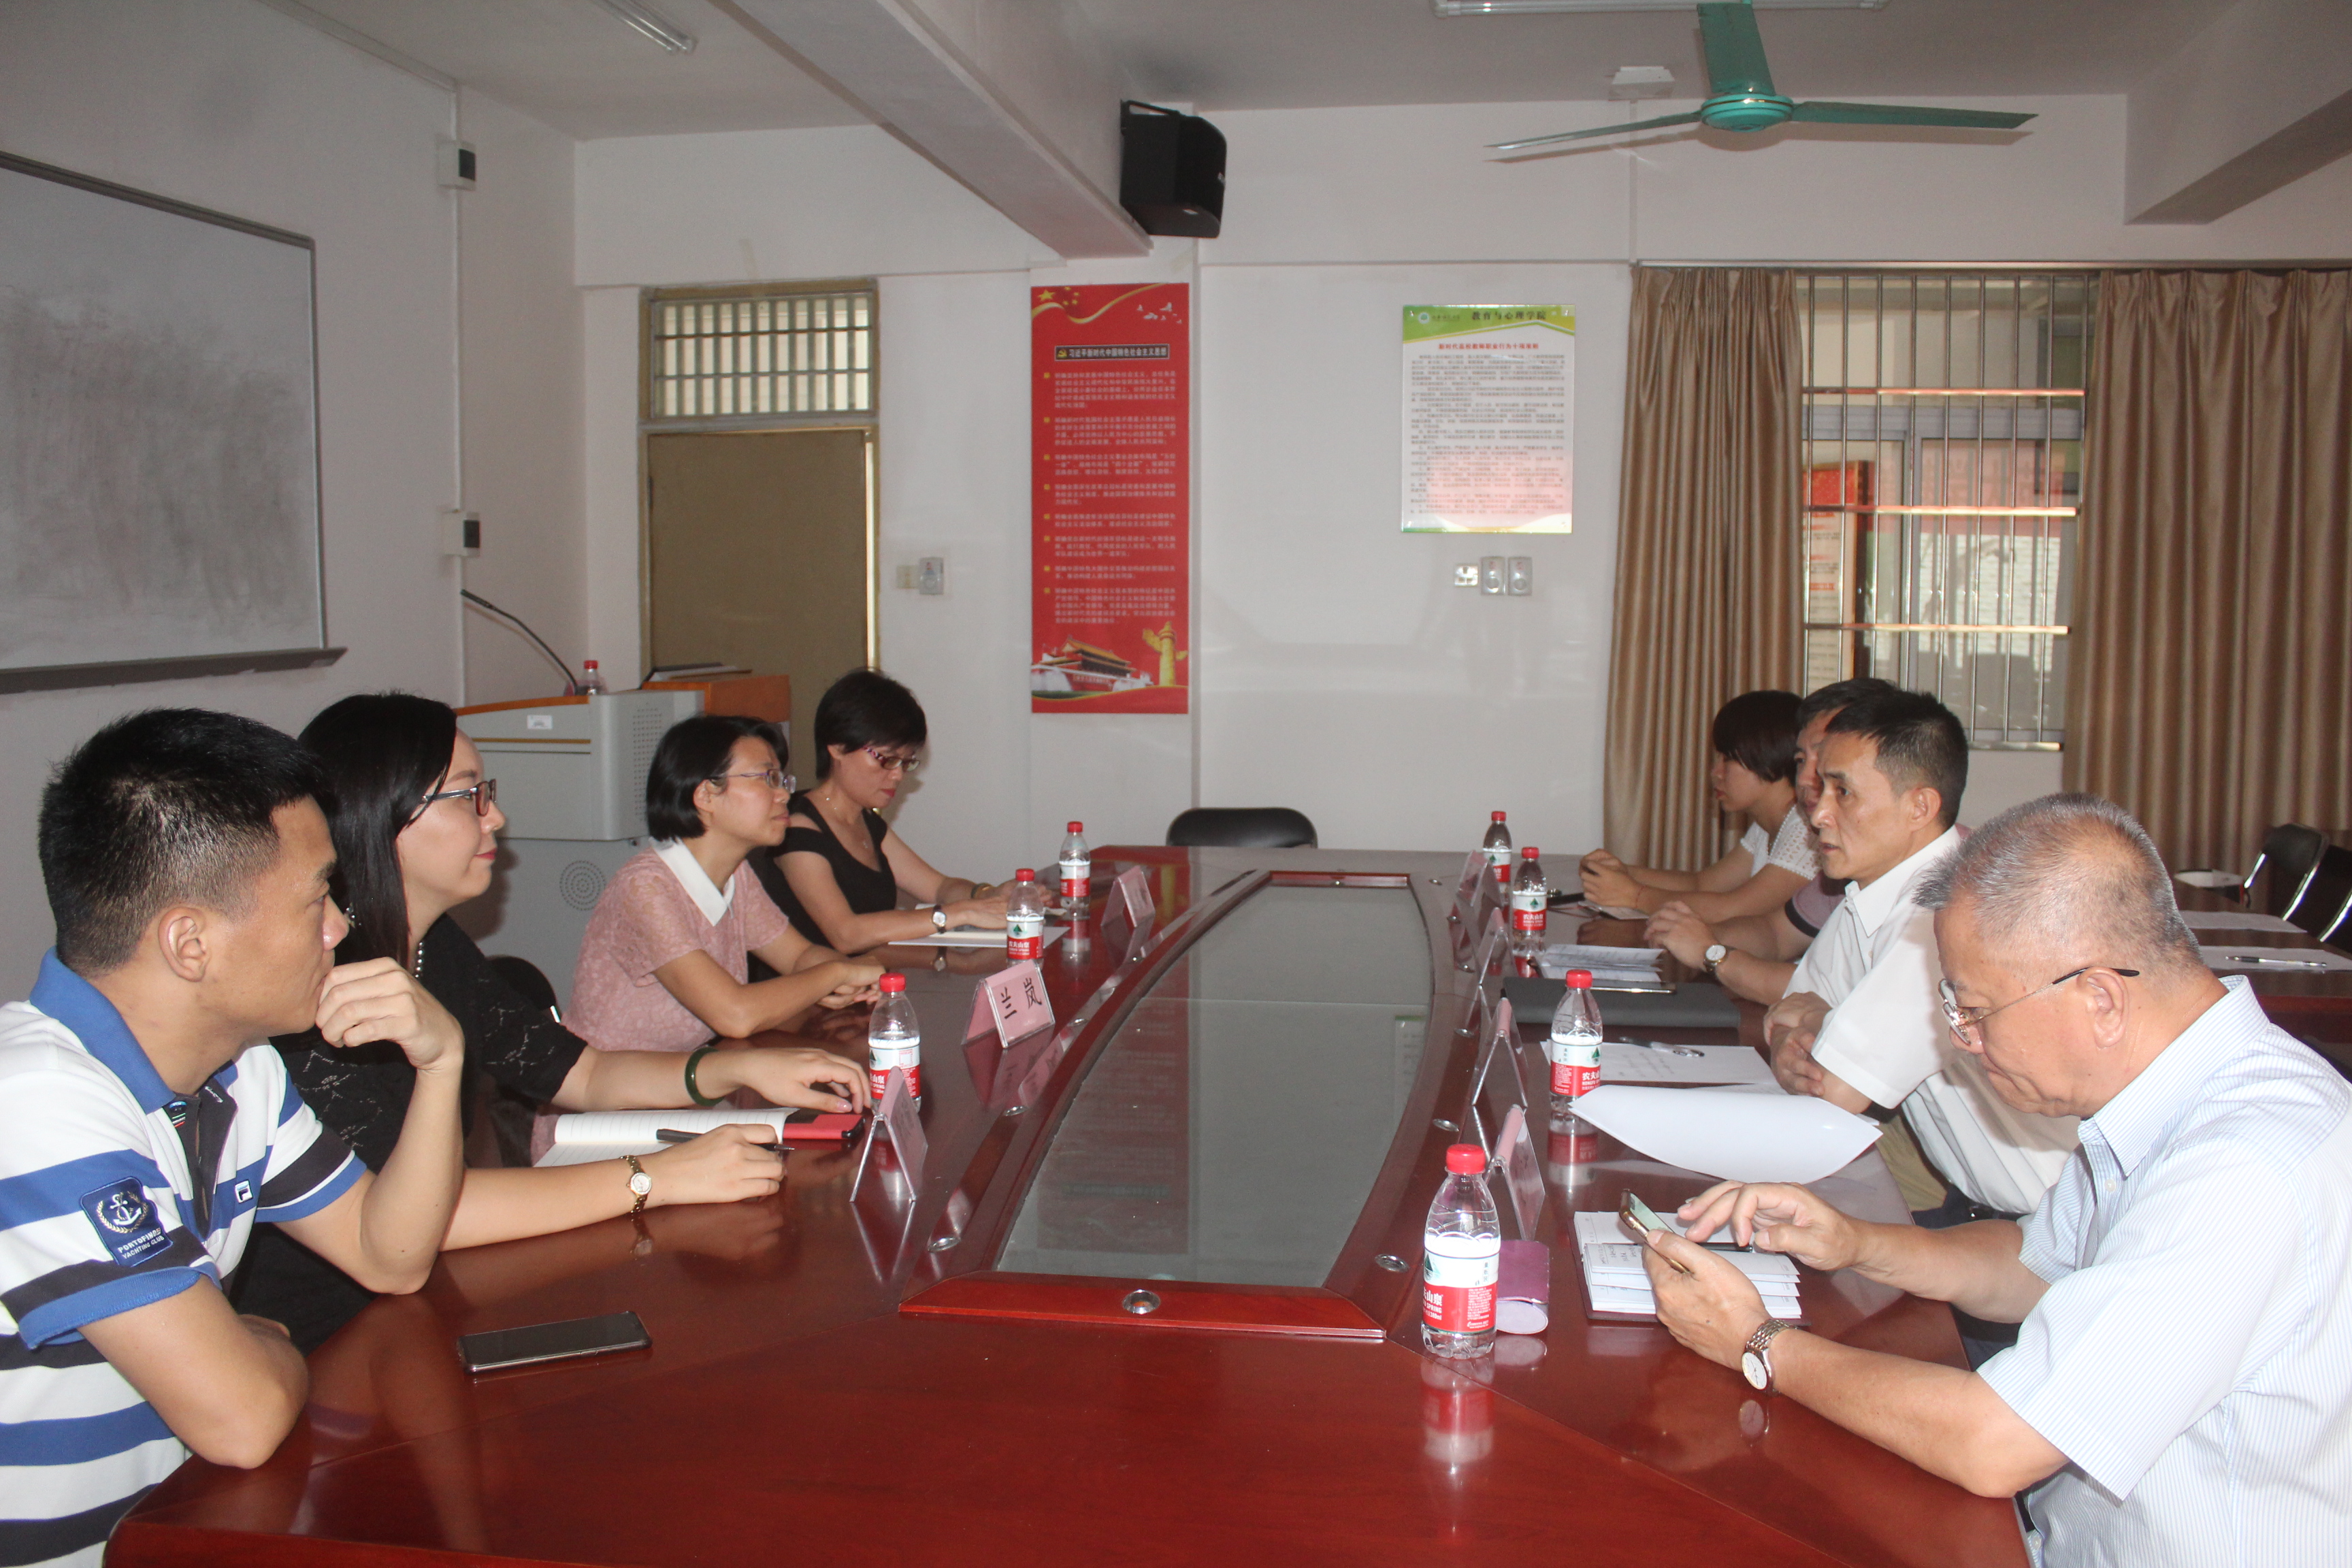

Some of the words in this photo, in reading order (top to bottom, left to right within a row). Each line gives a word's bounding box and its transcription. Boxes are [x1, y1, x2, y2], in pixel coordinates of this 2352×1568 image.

[1472, 310, 1546, 320] 教育与心理学院
[1068, 347, 1166, 358] 习近平新时代中国特色社会主义思想
[122, 1243, 151, 1260] YACHTING
[151, 1235, 165, 1245] CLUB
[1426, 1302, 1442, 1314] SPRING
